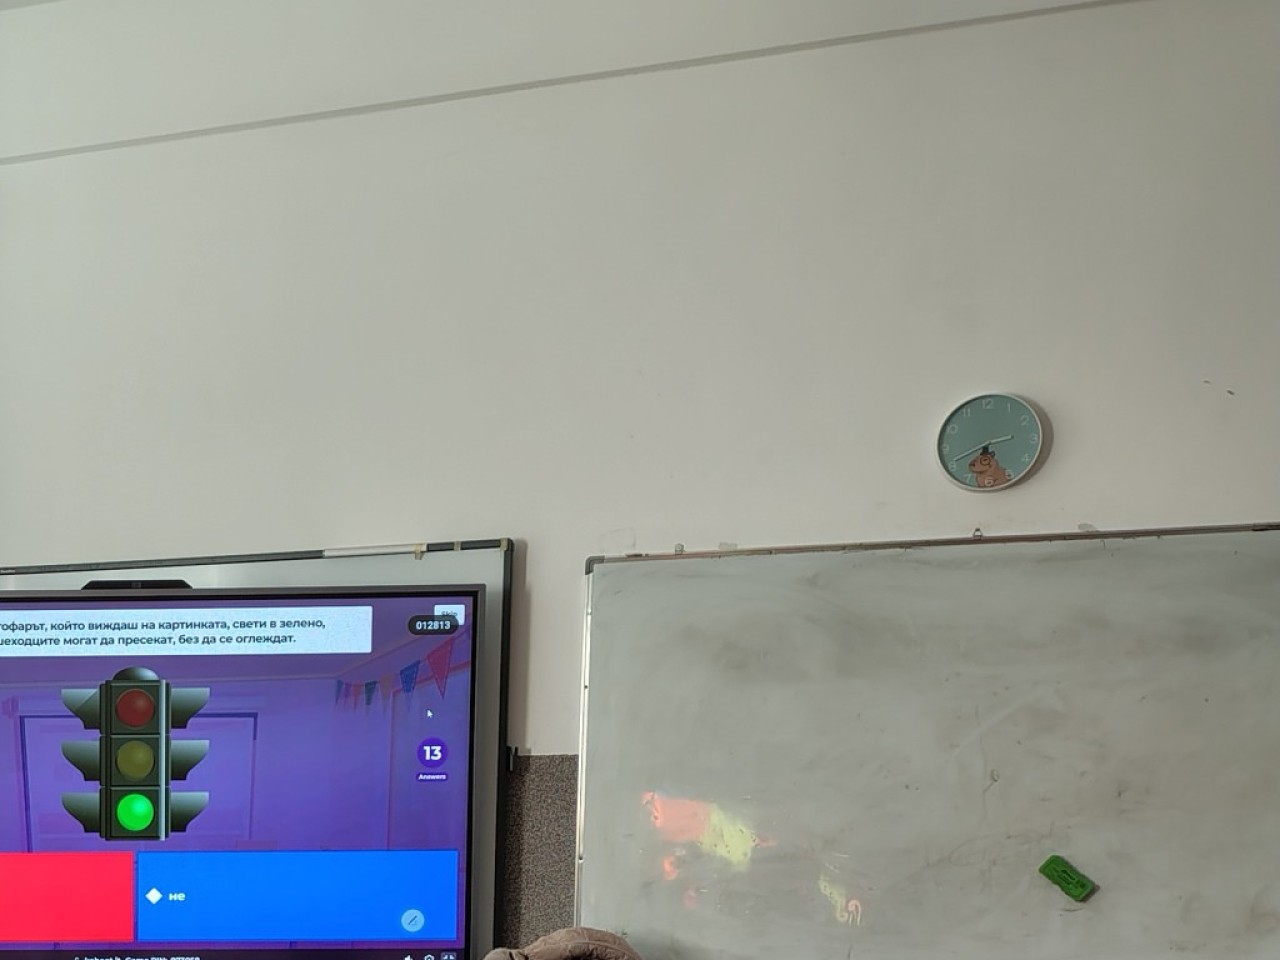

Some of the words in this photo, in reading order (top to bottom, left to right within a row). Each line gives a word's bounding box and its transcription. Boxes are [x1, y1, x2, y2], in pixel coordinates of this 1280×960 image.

[982, 399, 994, 409] 12
[962, 407, 971, 417] 11
[1021, 415, 1029, 426] 2
[1030, 433, 1038, 444] 3
[1022, 453, 1029, 464] 4
[963, 473, 971, 483] 7
[985, 476, 994, 486] 6
[50, 620, 85, 631] който
[88, 621, 138, 632] виждаш
[141, 621, 156, 630] на
[158, 620, 230, 631] картинката,
[232, 619, 267, 629] свети
[270, 619, 277, 628] в
[279, 618, 326, 630] зелено,
[415, 620, 451, 630] 012813
[63, 635, 97, 645] могат
[99, 636, 115, 647] да
[118, 635, 176, 647] пресекат,
[178, 633, 200, 645] без
[201, 635, 217, 646] да
[219, 634, 233, 644] се
[235, 633, 296, 645] оглеждат.
[423, 745, 442, 761] 13
[168, 893, 186, 901] не
